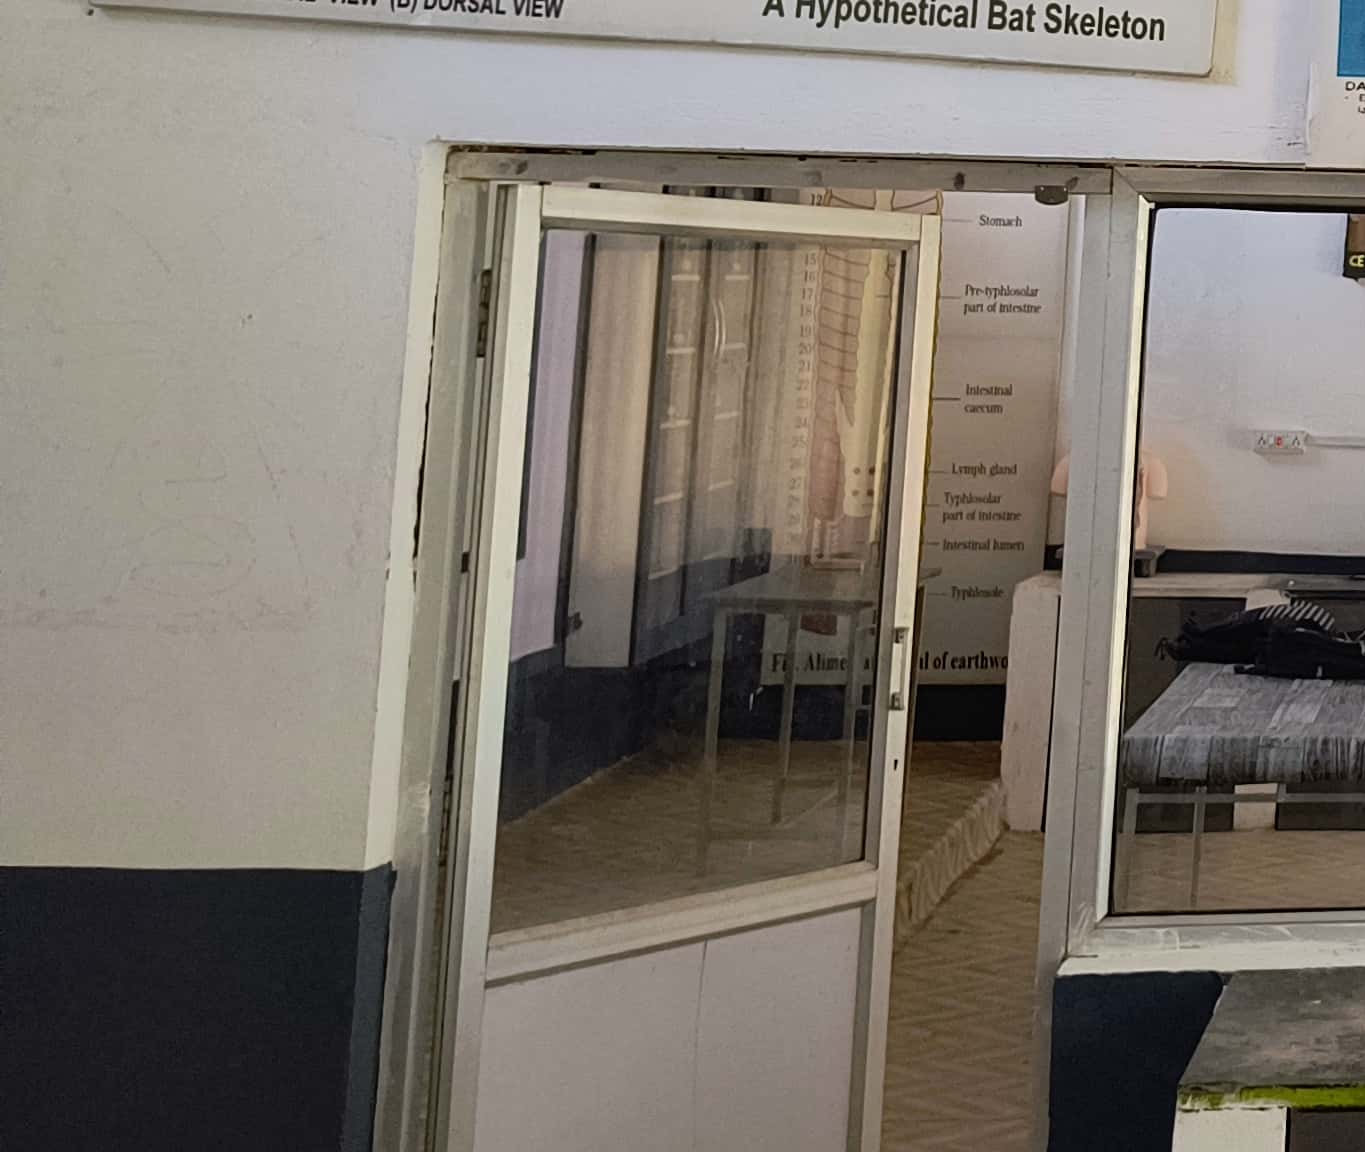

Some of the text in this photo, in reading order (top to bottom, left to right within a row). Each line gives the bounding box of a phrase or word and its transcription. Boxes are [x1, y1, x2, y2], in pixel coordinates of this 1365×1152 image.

[988, 0, 1036, 32] Bat
[1044, 3, 1165, 41] Skeleton
[979, 215, 1022, 227] Stomach
[963, 304, 983, 315] part
[987, 303, 997, 313] of
[966, 384, 1012, 396] Intestinal
[990, 464, 1017, 476] gland
[933, 651, 1008, 669] of earthwo
